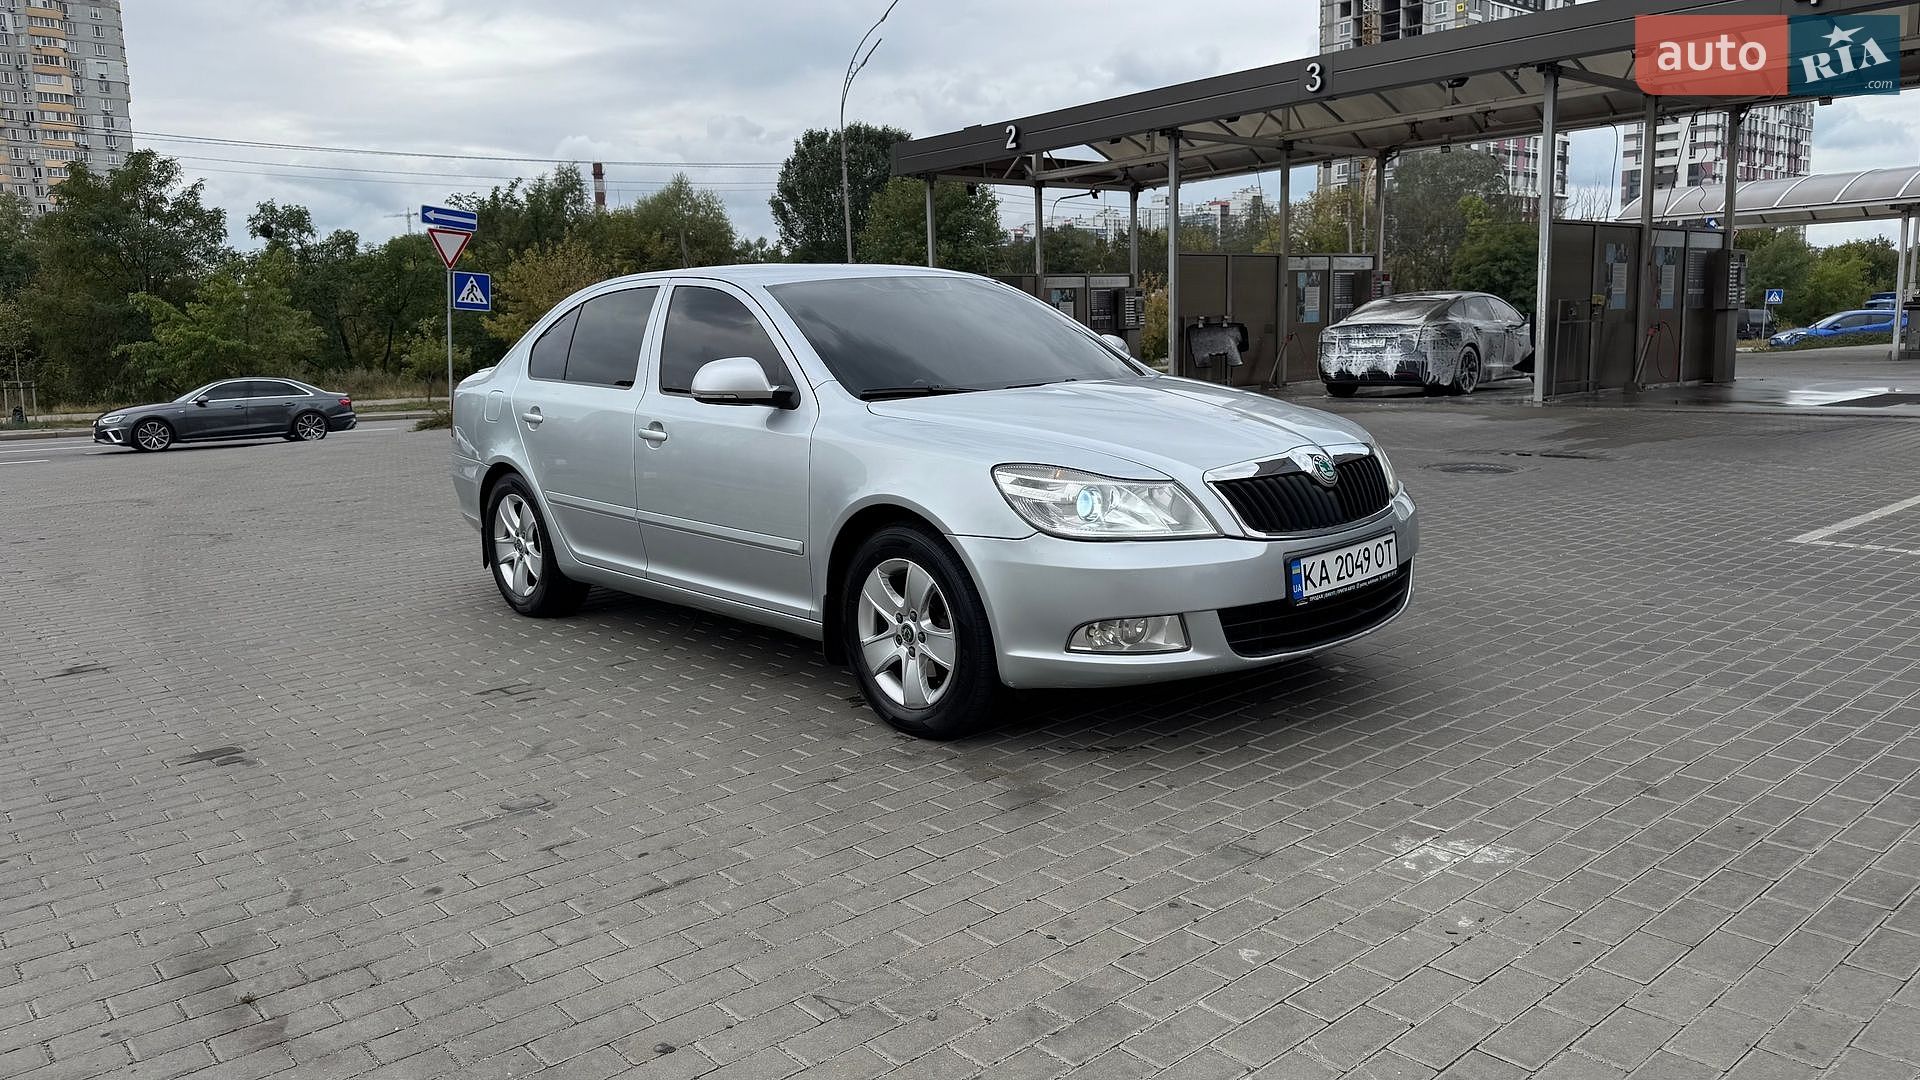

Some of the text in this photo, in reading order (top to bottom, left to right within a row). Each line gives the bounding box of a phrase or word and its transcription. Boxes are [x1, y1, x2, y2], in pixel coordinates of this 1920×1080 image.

[1305, 62, 1322, 92] 3
[1005, 125, 1017, 149] 2
[1303, 560, 1331, 590] KA
[1335, 547, 1370, 581] 2049
[1375, 539, 1393, 567] OT
[1293, 584, 1303, 593] UA
